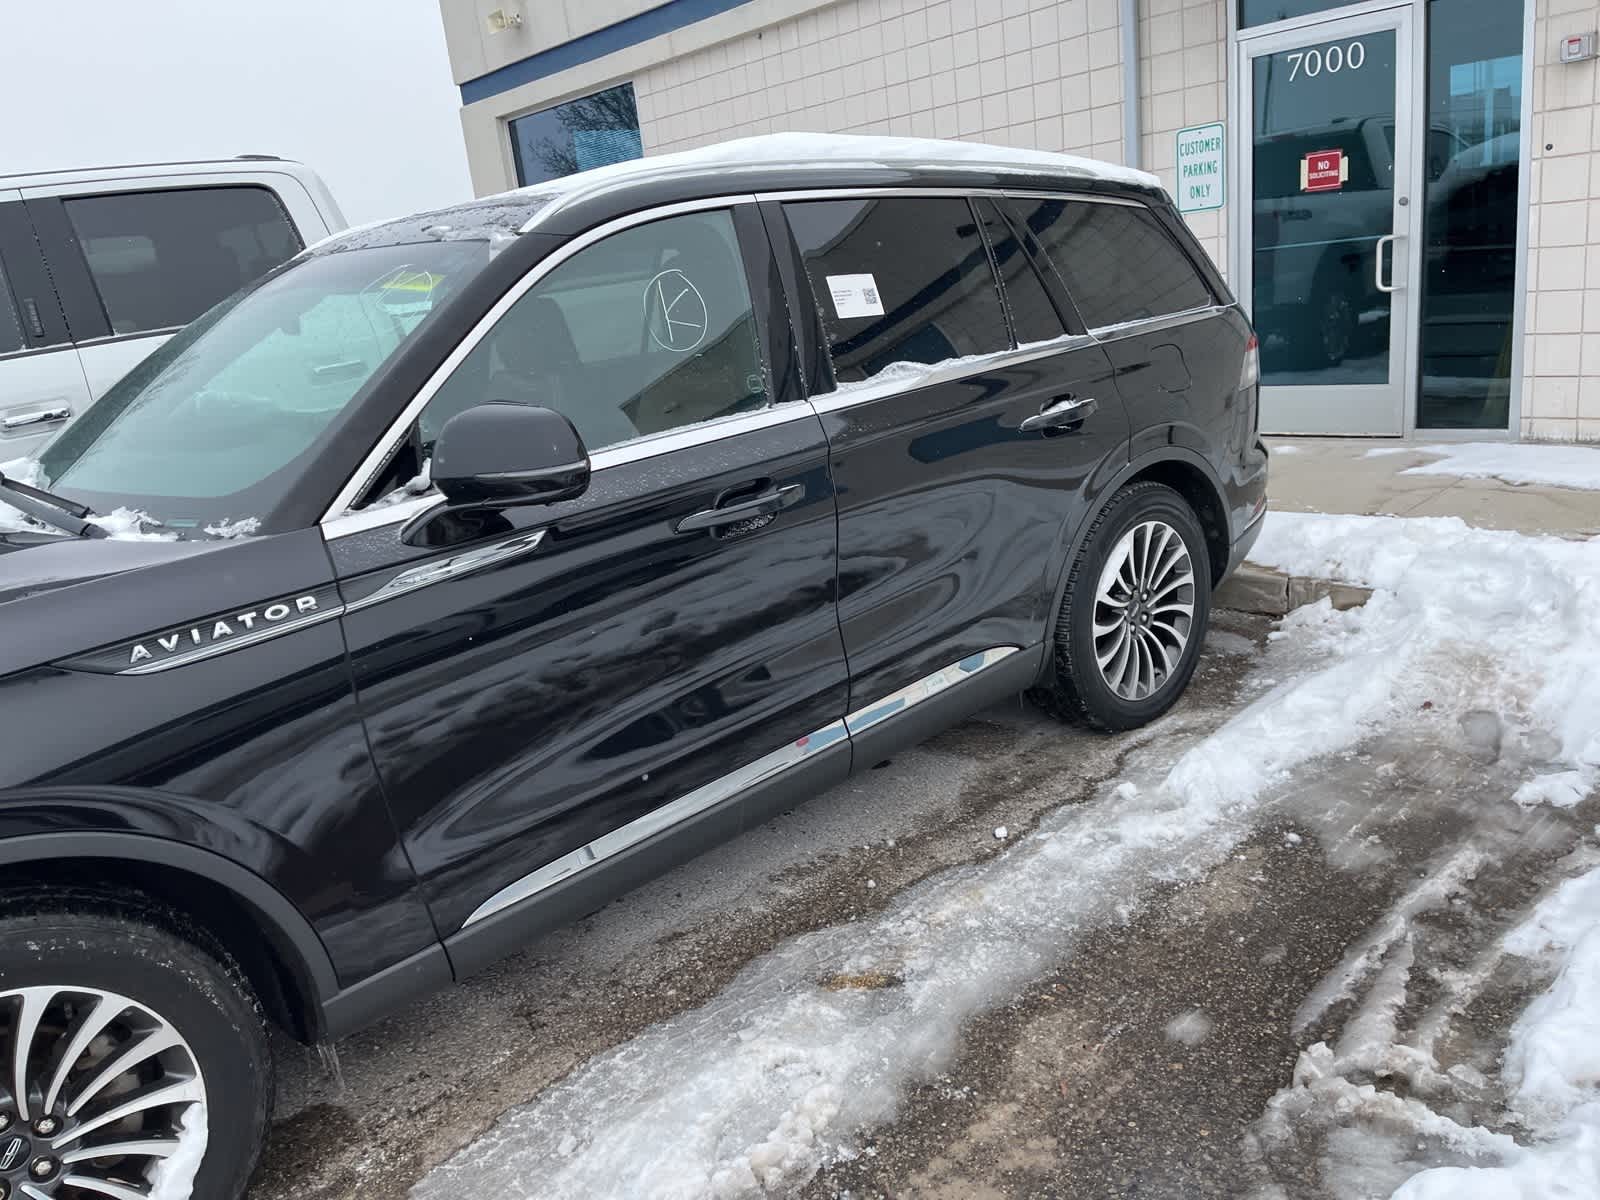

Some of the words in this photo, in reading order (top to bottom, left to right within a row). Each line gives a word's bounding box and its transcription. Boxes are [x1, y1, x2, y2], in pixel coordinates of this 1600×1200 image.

[1287, 41, 1365, 82] 7000
[1180, 137, 1221, 157] CUSTOMER
[1183, 160, 1217, 178] PARKING
[1318, 160, 1330, 171] NO
[1190, 183, 1211, 200] ONLY
[129, 595, 319, 664] AVIATOR
